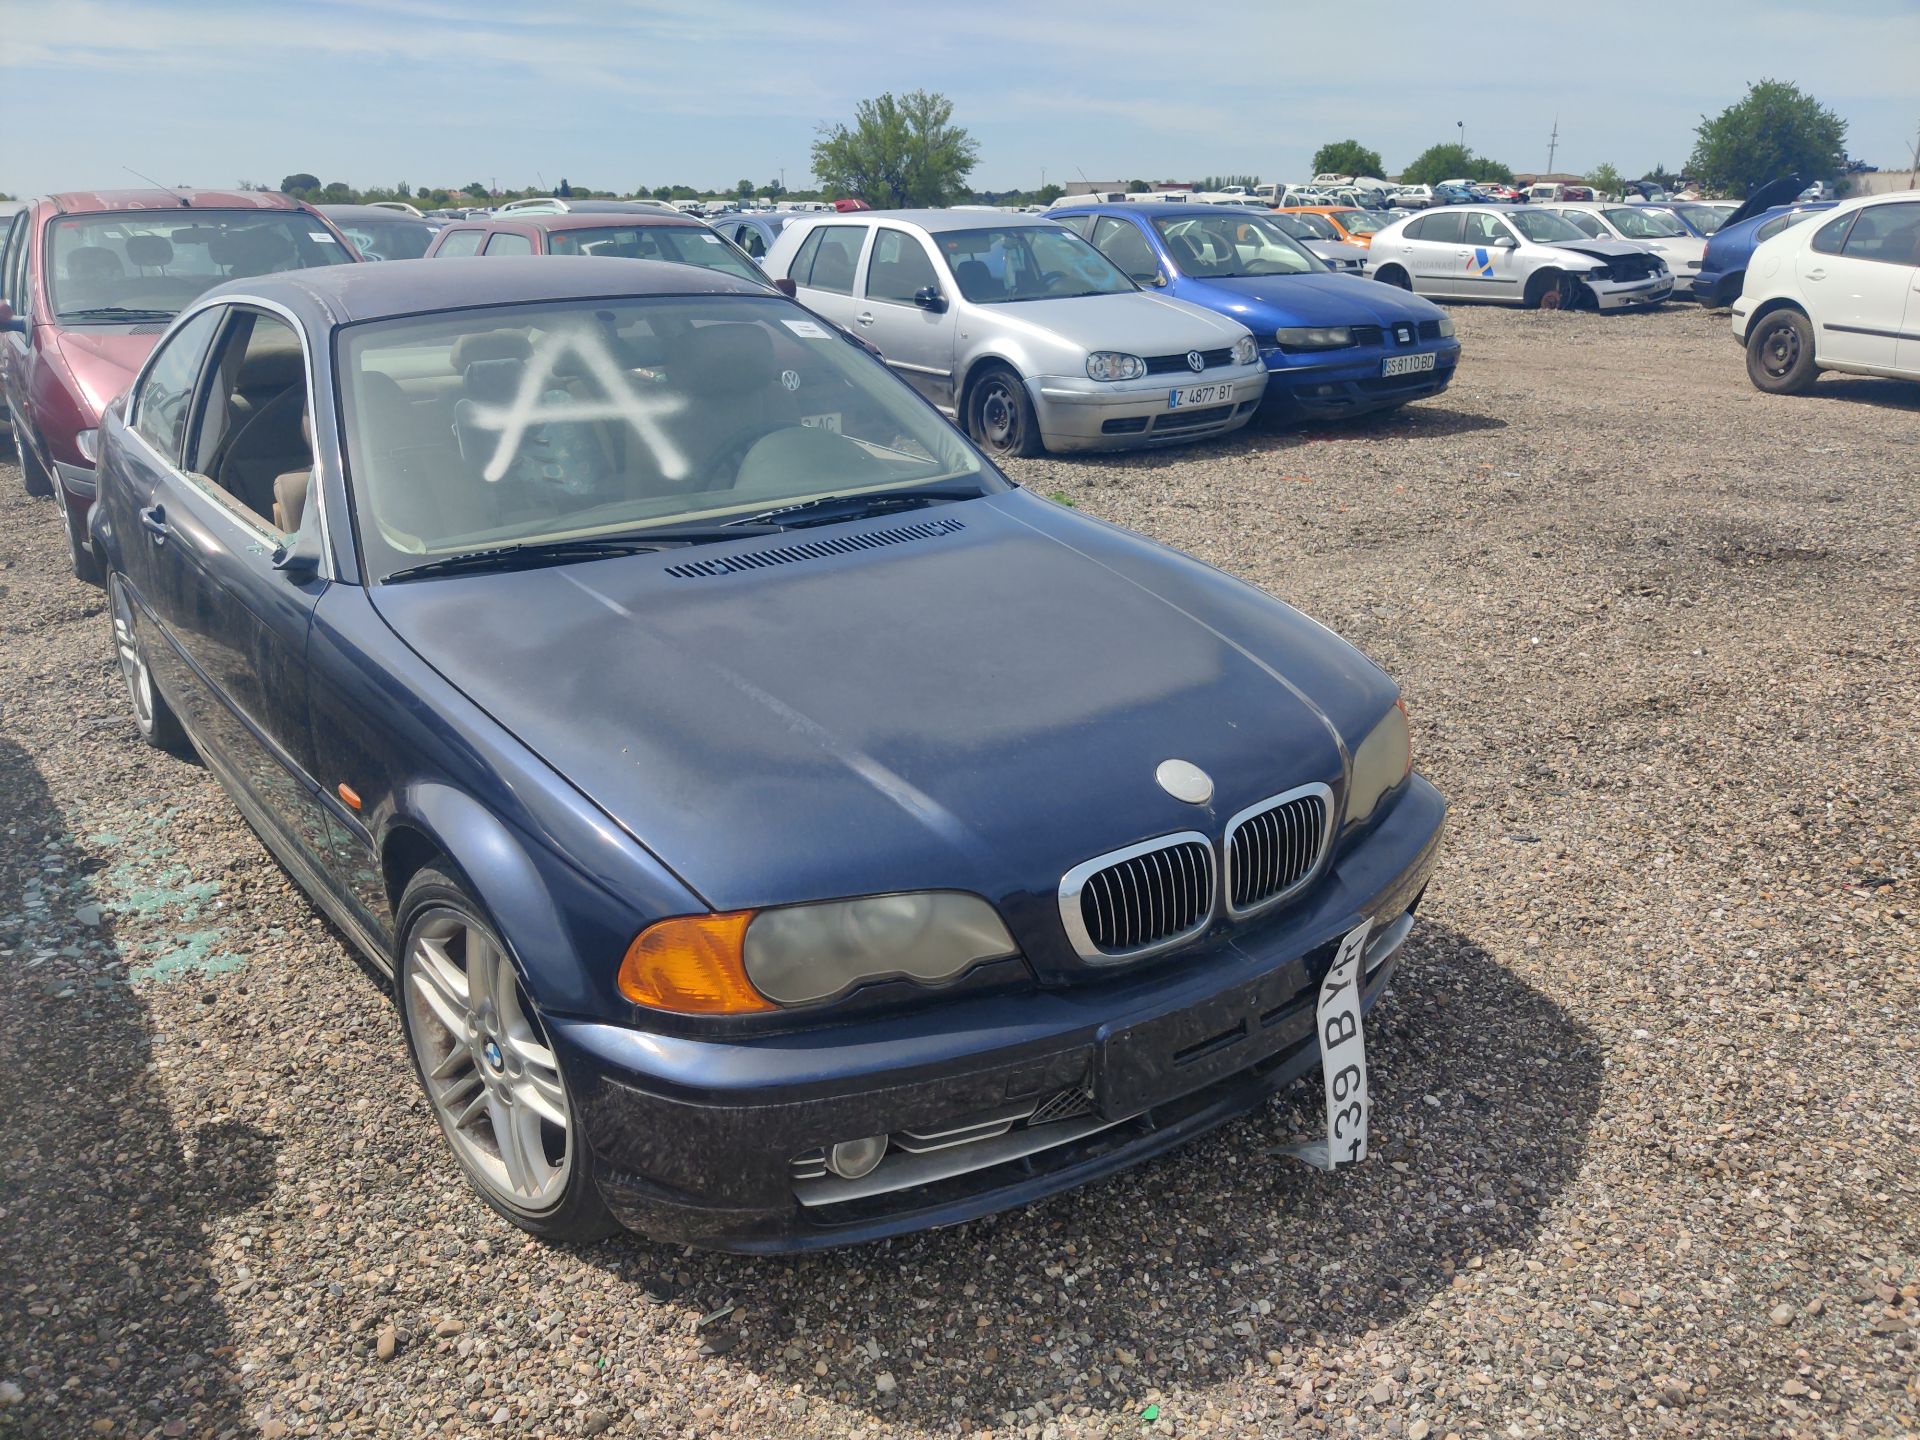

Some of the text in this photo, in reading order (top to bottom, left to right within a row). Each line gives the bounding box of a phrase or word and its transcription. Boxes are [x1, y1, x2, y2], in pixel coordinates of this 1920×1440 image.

[1410, 260, 1453, 270] ADUANAS
[471, 325, 689, 482] A
[1189, 387, 1215, 404] 4877
[1219, 384, 1233, 400] BT
